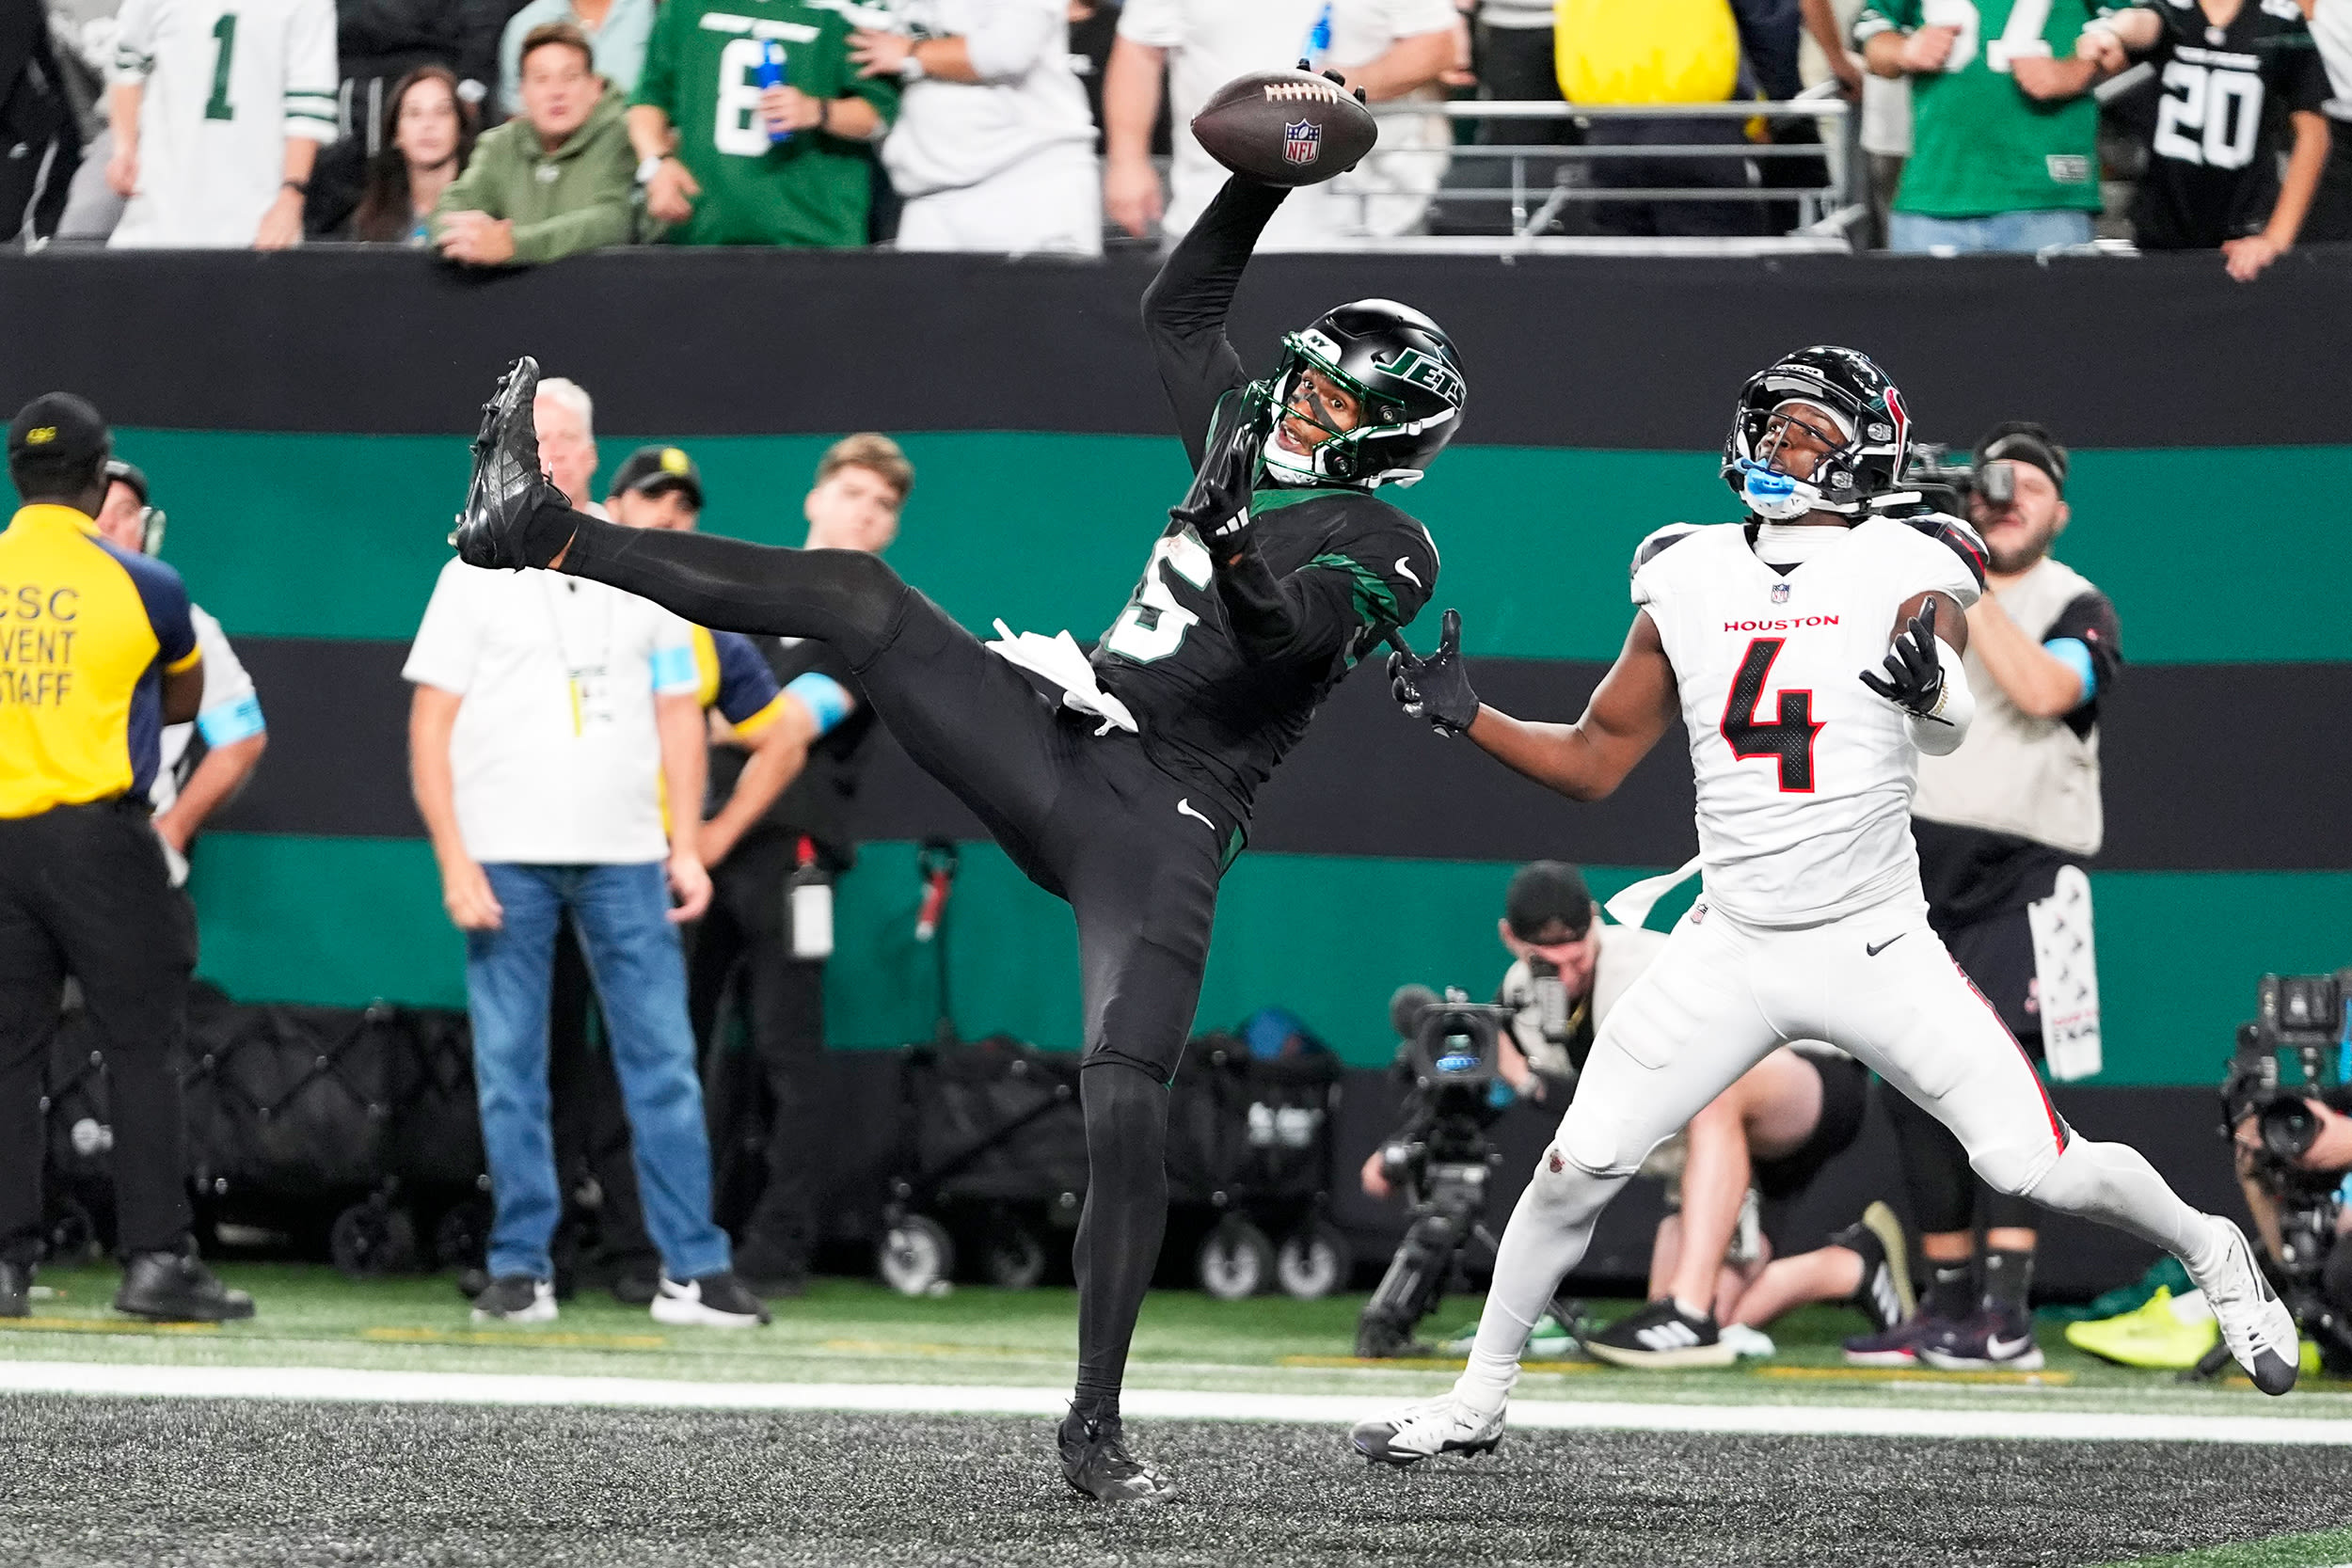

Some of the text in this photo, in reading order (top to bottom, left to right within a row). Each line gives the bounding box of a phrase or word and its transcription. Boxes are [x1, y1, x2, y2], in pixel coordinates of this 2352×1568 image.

[203, 12, 238, 121] 1
[2153, 58, 2264, 170] 20
[1287, 141, 1314, 162] NFL
[1370, 346, 1468, 411] JETS
[0, 585, 80, 622] SC
[1104, 530, 1214, 665] 5
[1724, 615, 1839, 632] HOUSTON
[0, 669, 72, 706] TAFF
[1720, 637, 1828, 793] 4
